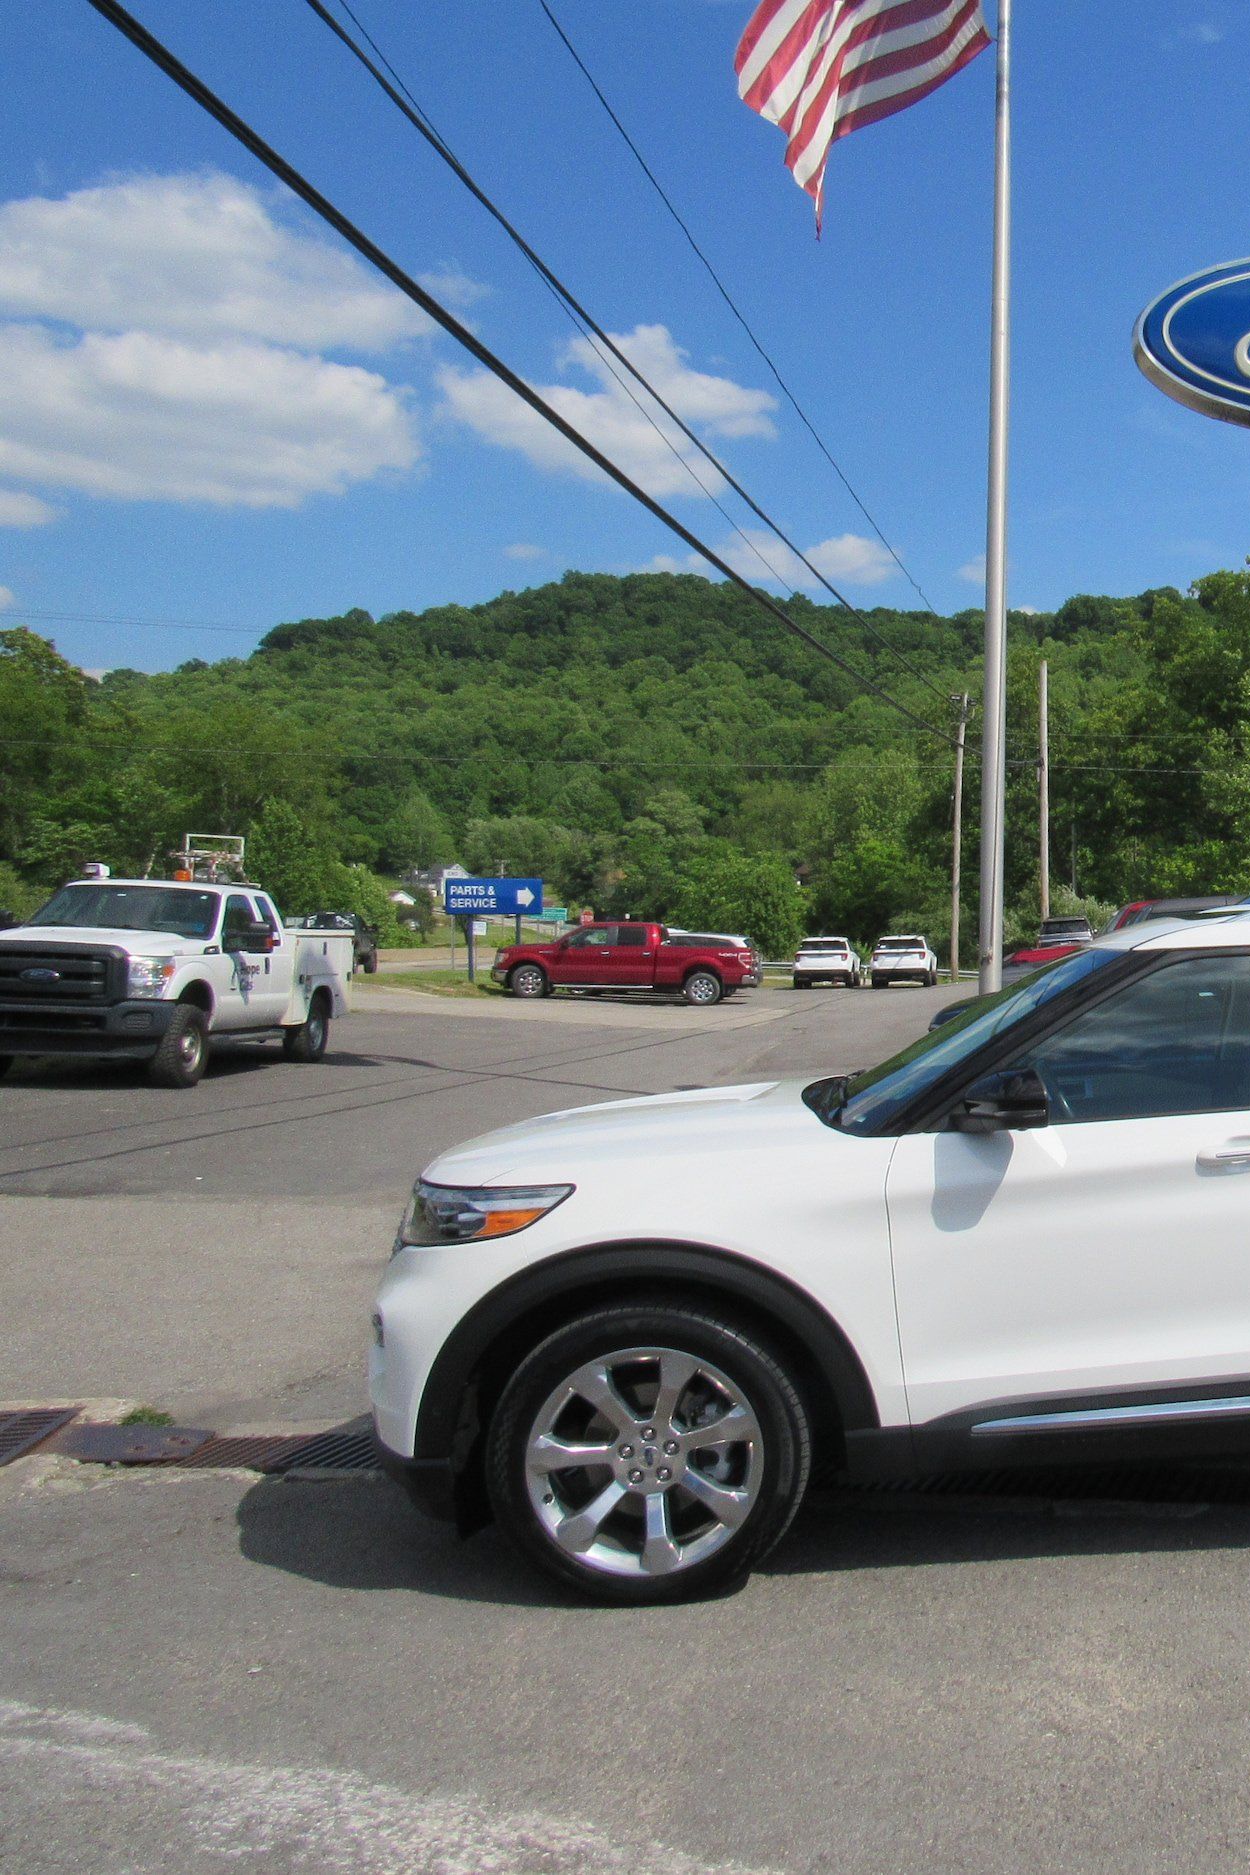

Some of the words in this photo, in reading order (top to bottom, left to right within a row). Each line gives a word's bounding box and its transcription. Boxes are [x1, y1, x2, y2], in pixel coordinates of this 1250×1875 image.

[449, 885, 485, 896] PARTS
[488, 885, 496, 896] &
[450, 897, 497, 908] SERVICE
